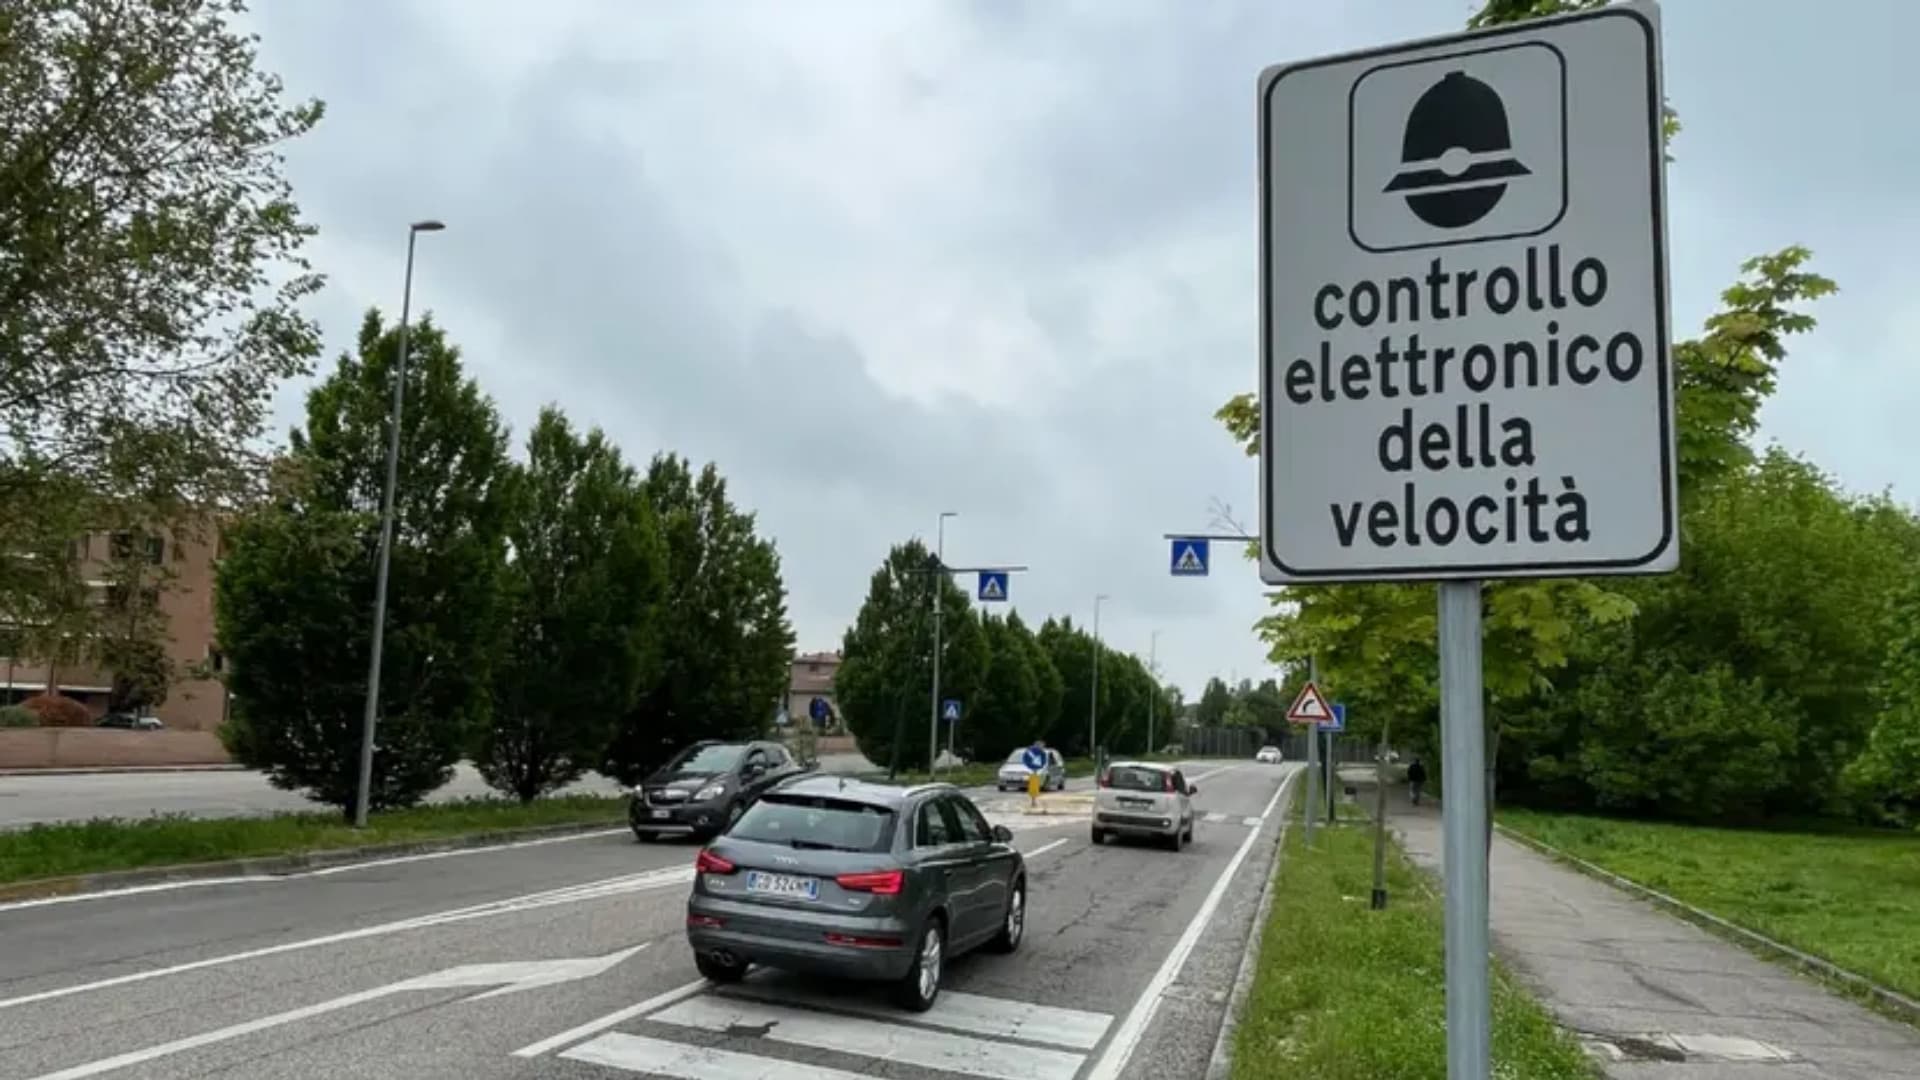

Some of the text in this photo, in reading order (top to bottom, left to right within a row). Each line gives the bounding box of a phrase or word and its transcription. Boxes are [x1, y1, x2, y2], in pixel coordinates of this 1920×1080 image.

[1313, 244, 1608, 331] controllo
[1284, 320, 1643, 405] elettronico
[1378, 402, 1536, 473] della
[1330, 476, 1591, 548] velocità
